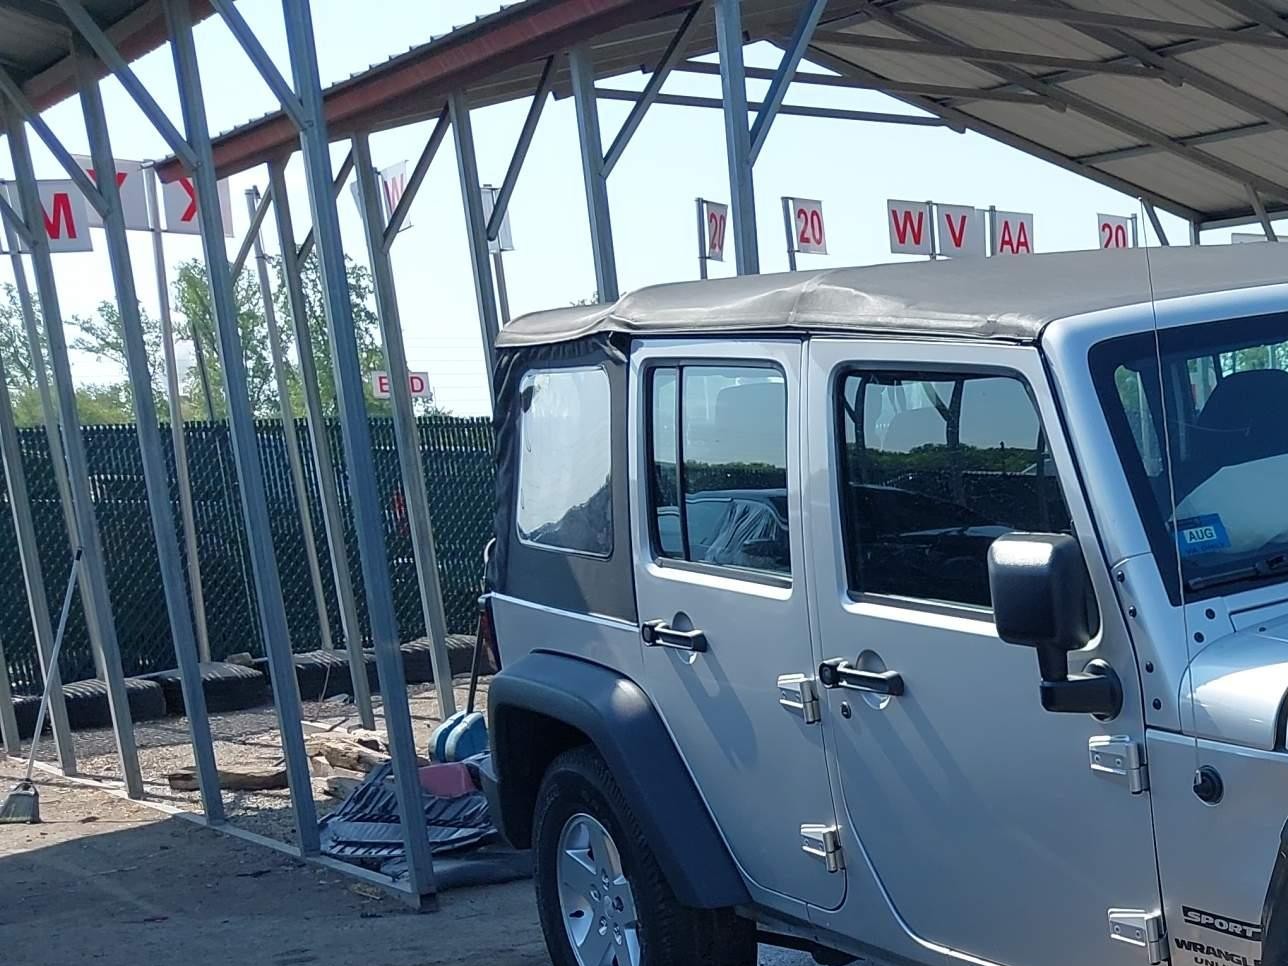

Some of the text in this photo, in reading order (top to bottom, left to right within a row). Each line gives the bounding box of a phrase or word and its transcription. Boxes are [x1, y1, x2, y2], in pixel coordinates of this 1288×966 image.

[797, 208, 823, 246] 20
[892, 209, 924, 245] W
[945, 213, 967, 248] V
[1000, 220, 1031, 254] AA
[1188, 527, 1214, 542] AUG
[1186, 910, 1262, 938] SPORT
